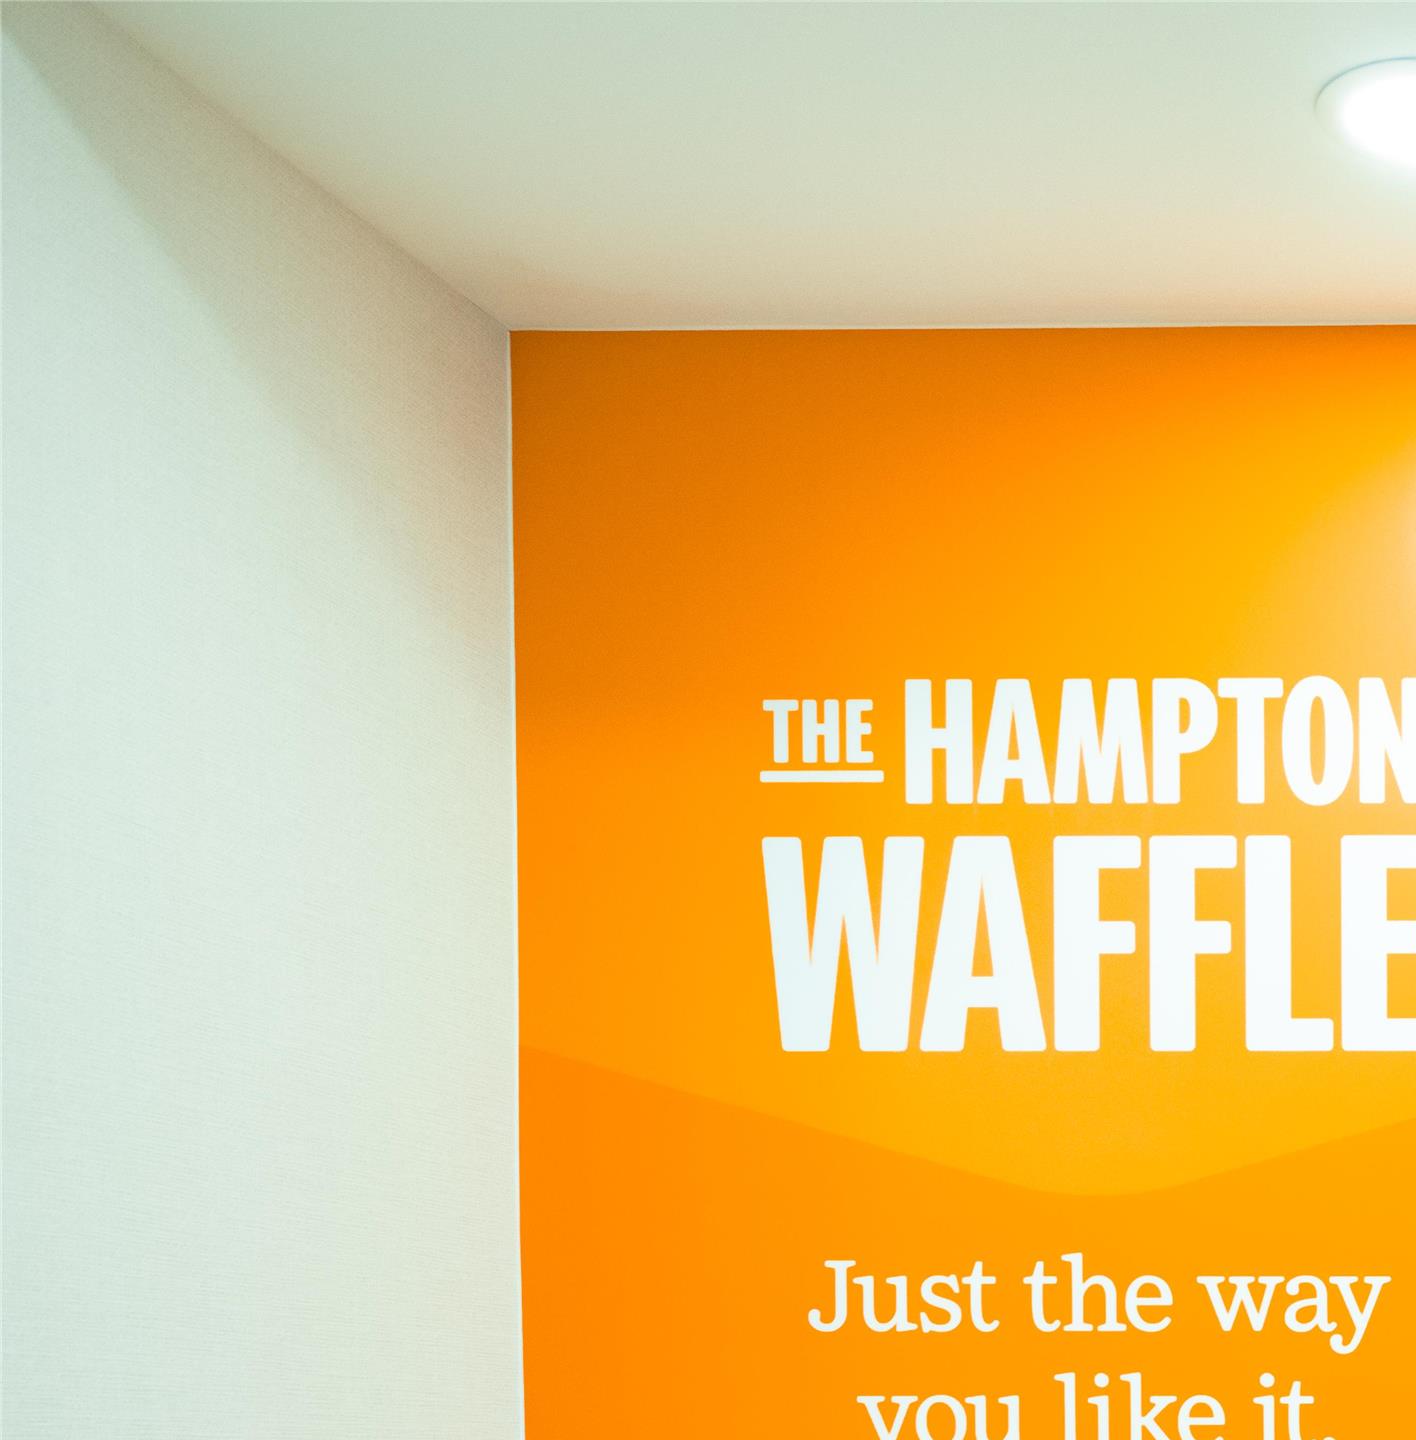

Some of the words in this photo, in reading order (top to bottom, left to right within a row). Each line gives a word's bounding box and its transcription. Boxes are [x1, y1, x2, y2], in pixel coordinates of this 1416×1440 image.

[762, 699, 873, 764] THE
[807, 1260, 1000, 1333] Just
[1023, 1252, 1173, 1332] the
[1196, 1275, 1391, 1355] way
